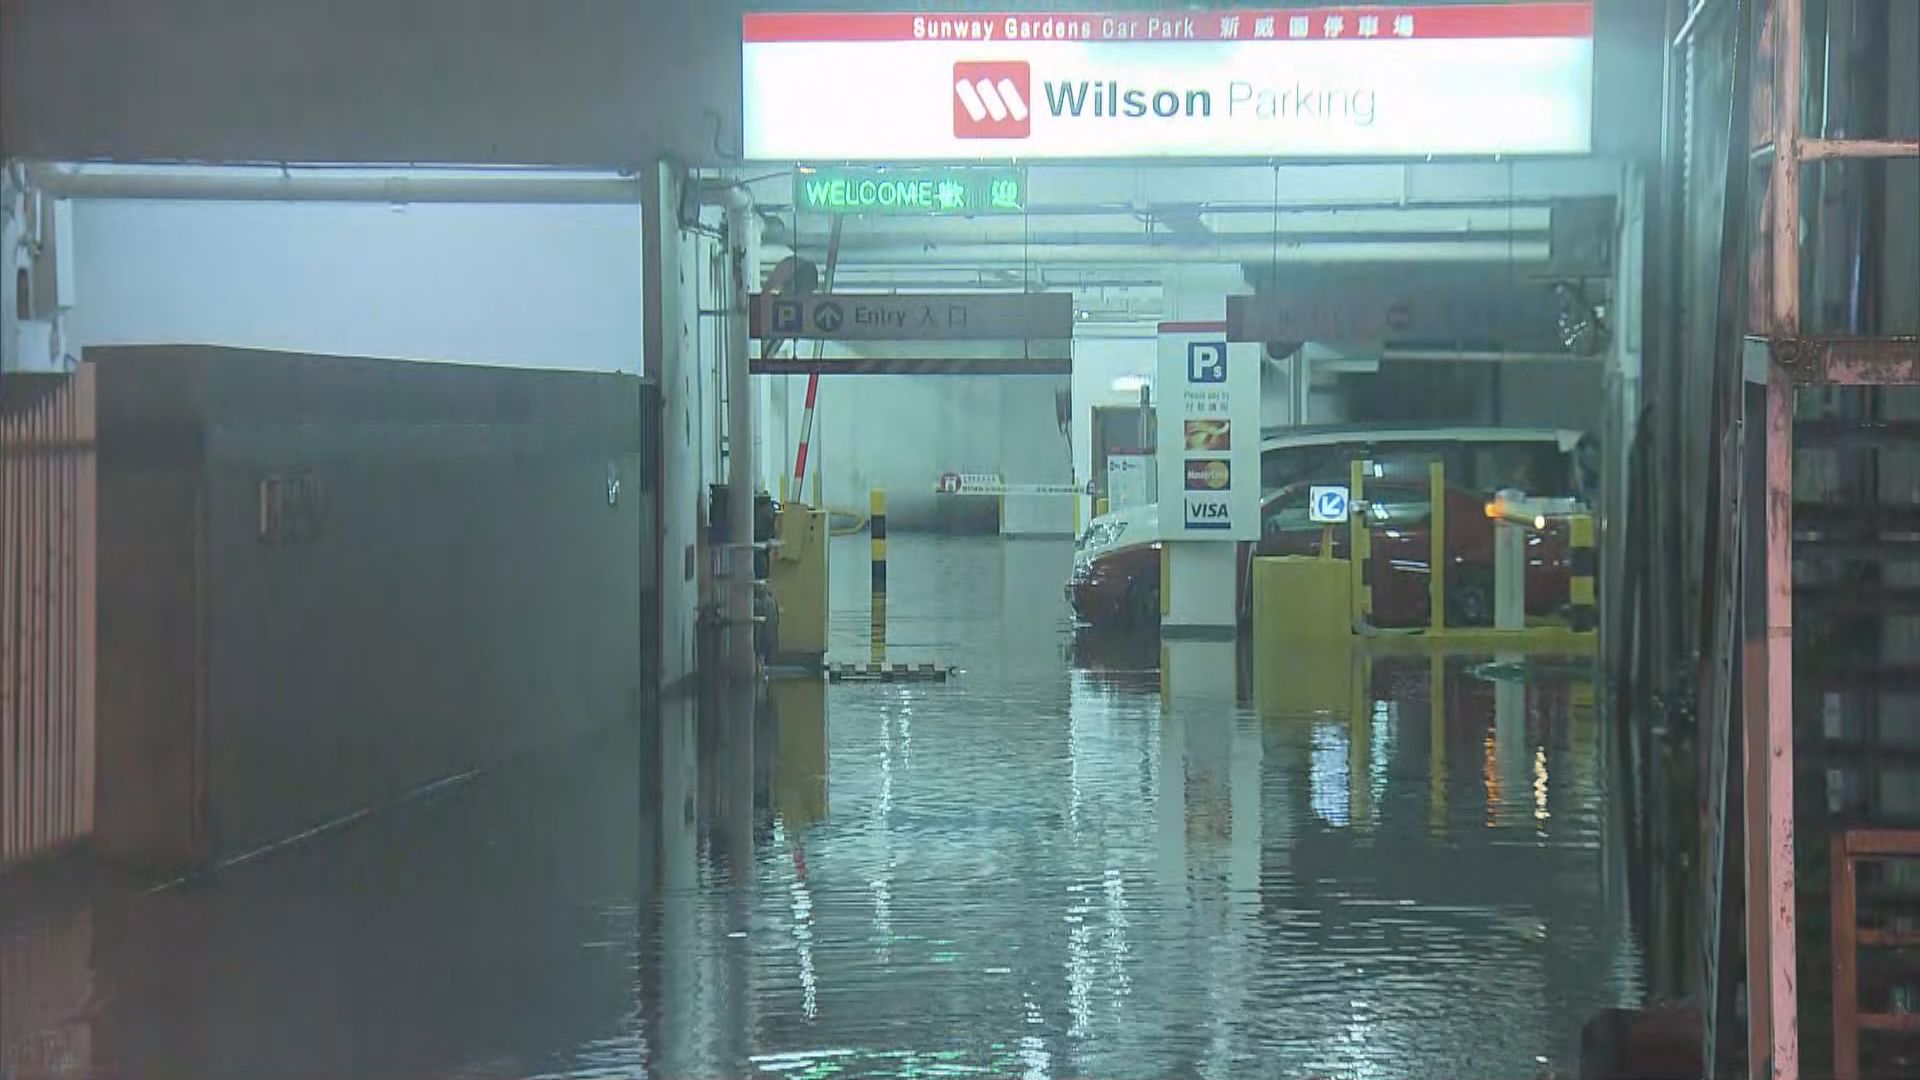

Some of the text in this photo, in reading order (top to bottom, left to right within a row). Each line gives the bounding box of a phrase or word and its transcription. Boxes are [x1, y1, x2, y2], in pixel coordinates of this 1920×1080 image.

[914, 18, 994, 40] Sunway
[1005, 17, 1091, 38] Gardens
[1103, 17, 1137, 37] Car
[1149, 16, 1194, 37] Park
[1044, 81, 1376, 126] Wilson Parking
[806, 181, 932, 206] WELCOME
[855, 305, 905, 327] Entry
[919, 306, 967, 328] 入口
[1191, 503, 1228, 518] VISA
